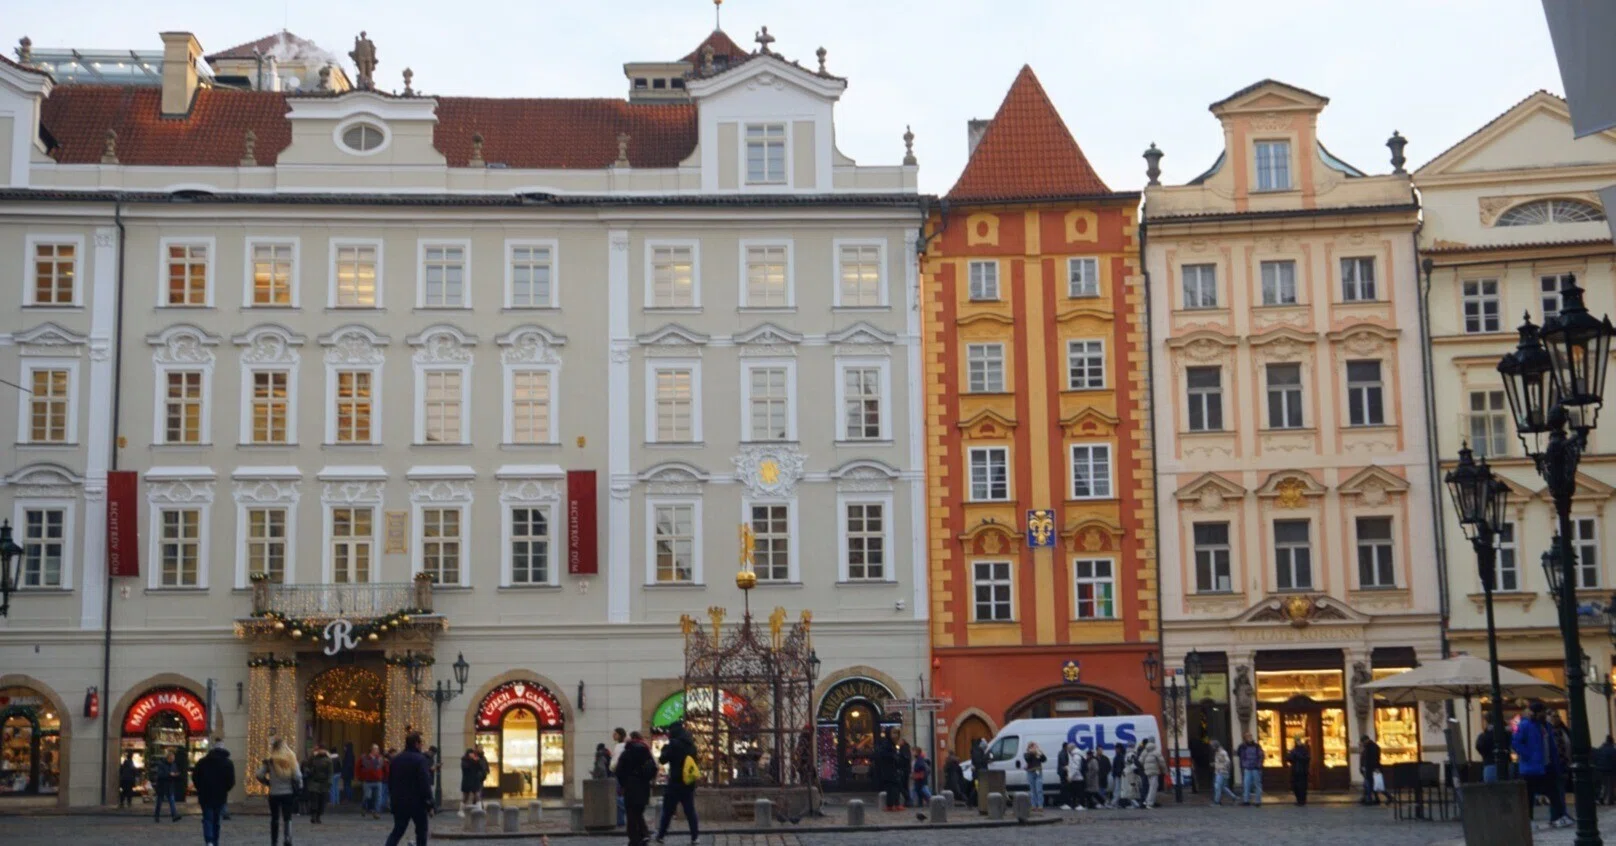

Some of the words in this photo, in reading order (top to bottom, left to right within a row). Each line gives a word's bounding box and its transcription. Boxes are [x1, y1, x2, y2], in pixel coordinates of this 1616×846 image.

[130, 698, 156, 727] MINI
[158, 693, 204, 721] MARKET
[485, 692, 511, 716] CZECH
[525, 691, 555, 717] GARNET
[1067, 723, 1137, 751] GLS
